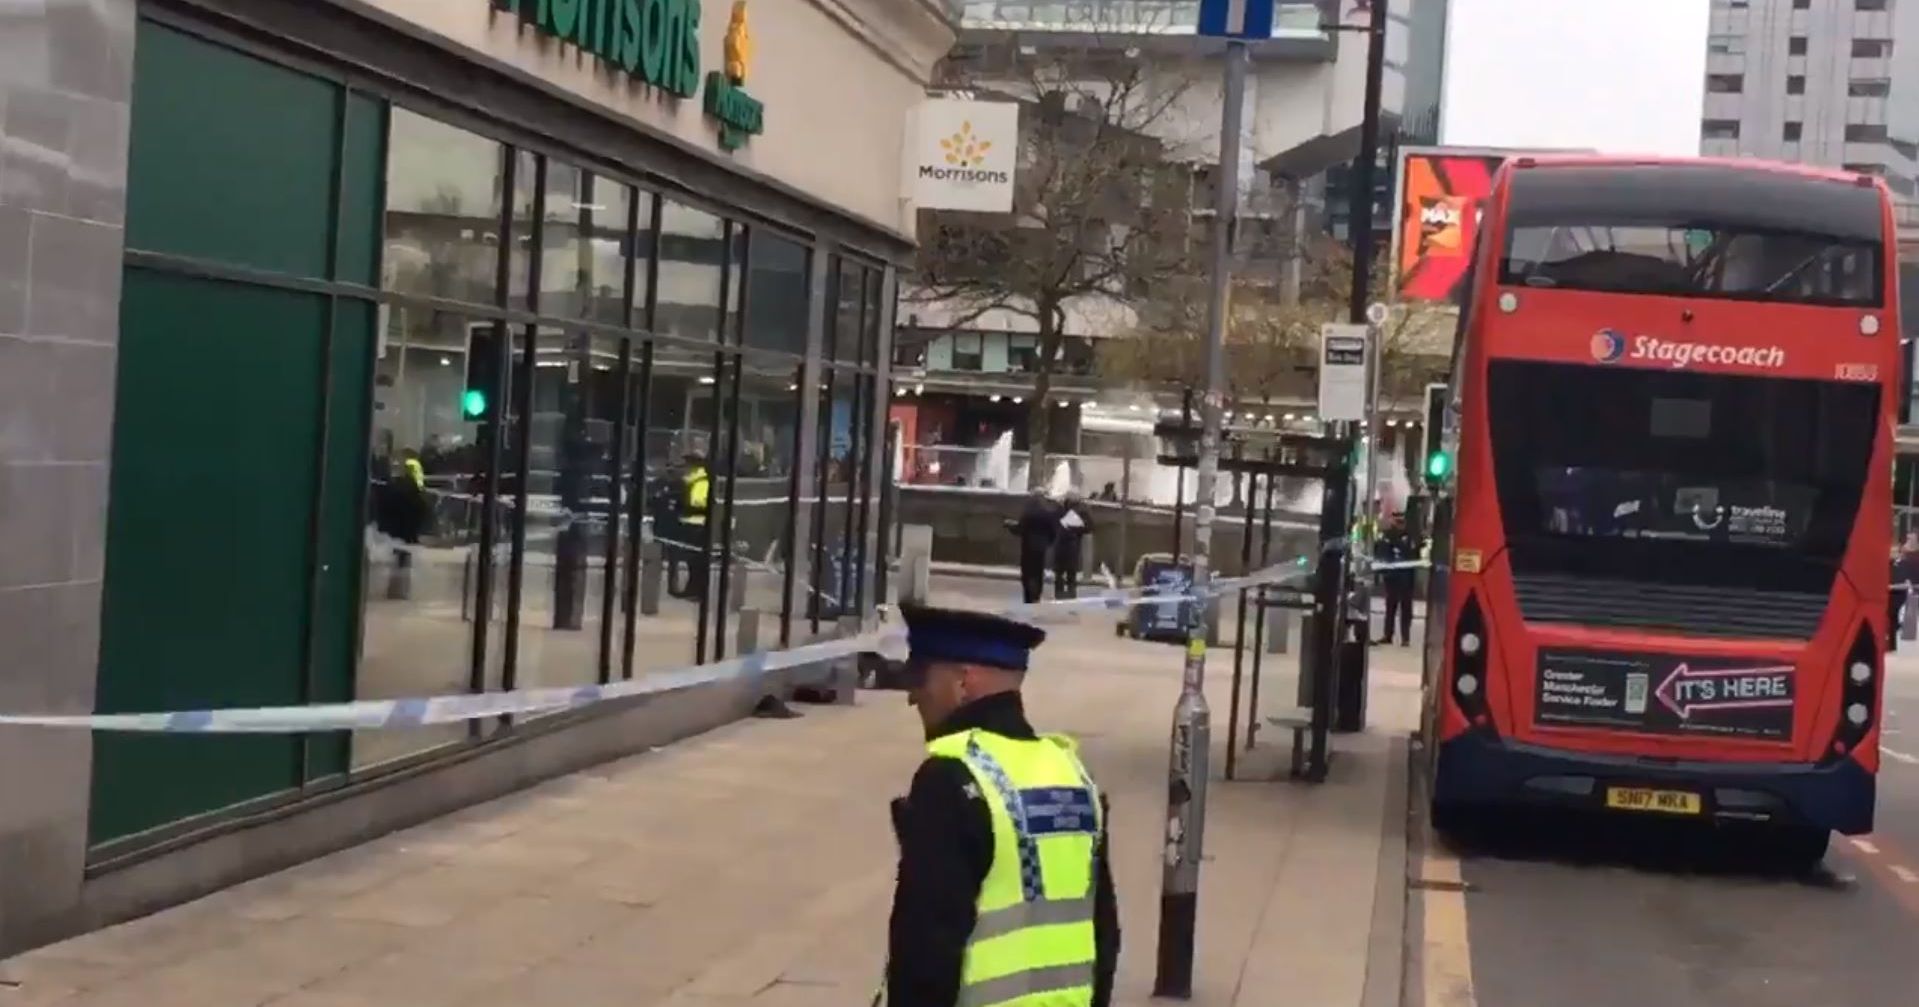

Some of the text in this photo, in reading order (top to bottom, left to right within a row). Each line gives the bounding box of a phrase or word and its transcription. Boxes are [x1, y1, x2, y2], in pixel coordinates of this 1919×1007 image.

[489, 0, 701, 99] rrisons
[919, 165, 1008, 183] Morrisons
[1630, 336, 1785, 368] Stagecoach
[1543, 669, 1584, 680] Greater
[1543, 681, 1607, 696] Manchester
[1675, 676, 1787, 700] IT'S HERE
[1542, 692, 1618, 707] Service Finder
